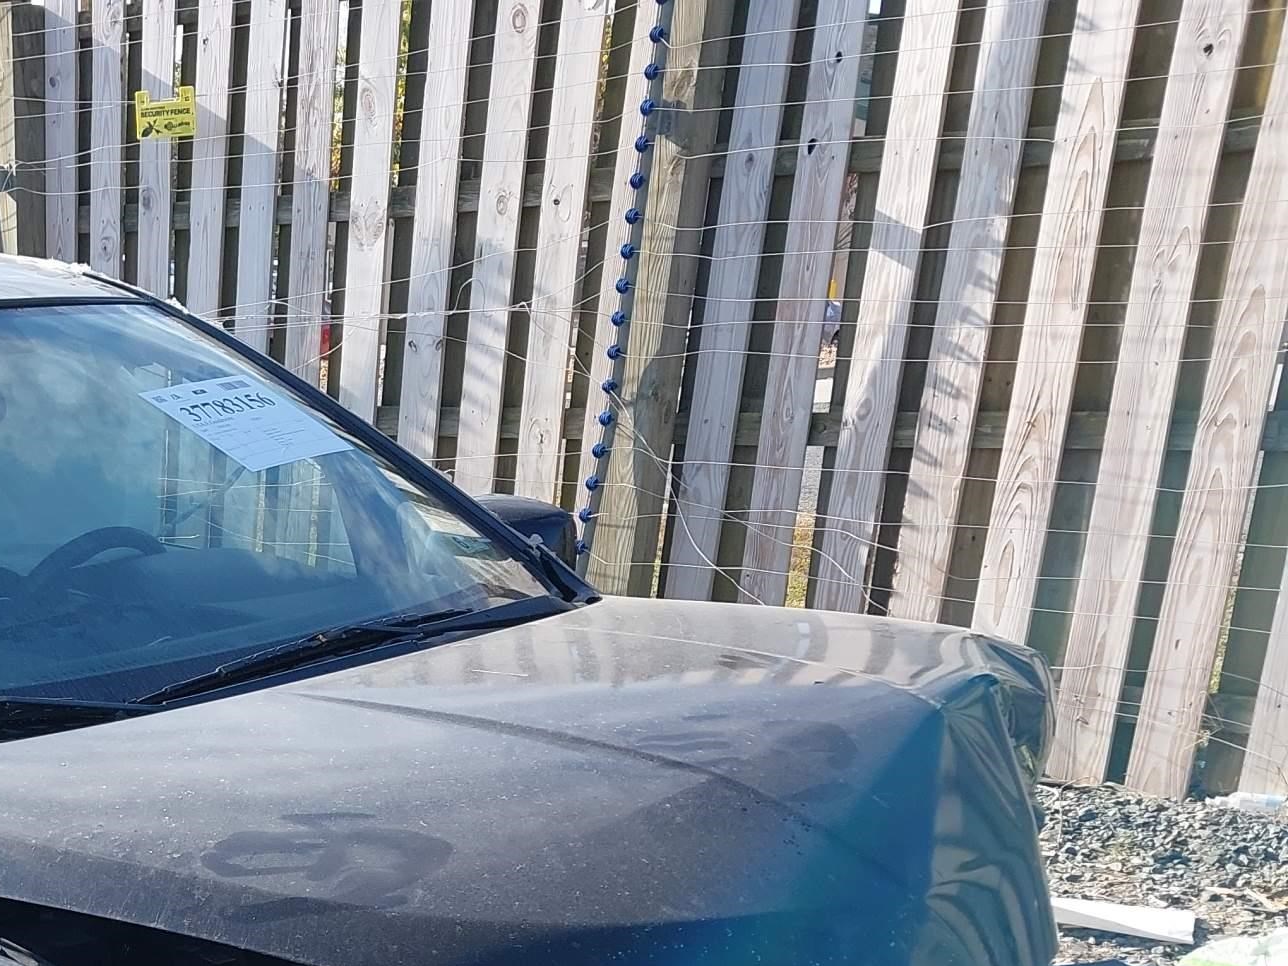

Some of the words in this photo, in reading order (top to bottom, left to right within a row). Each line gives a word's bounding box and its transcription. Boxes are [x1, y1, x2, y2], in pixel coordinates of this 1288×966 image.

[140, 109, 169, 118] SECURITY
[170, 107, 191, 116] FENCE
[179, 391, 276, 422] 37783156
